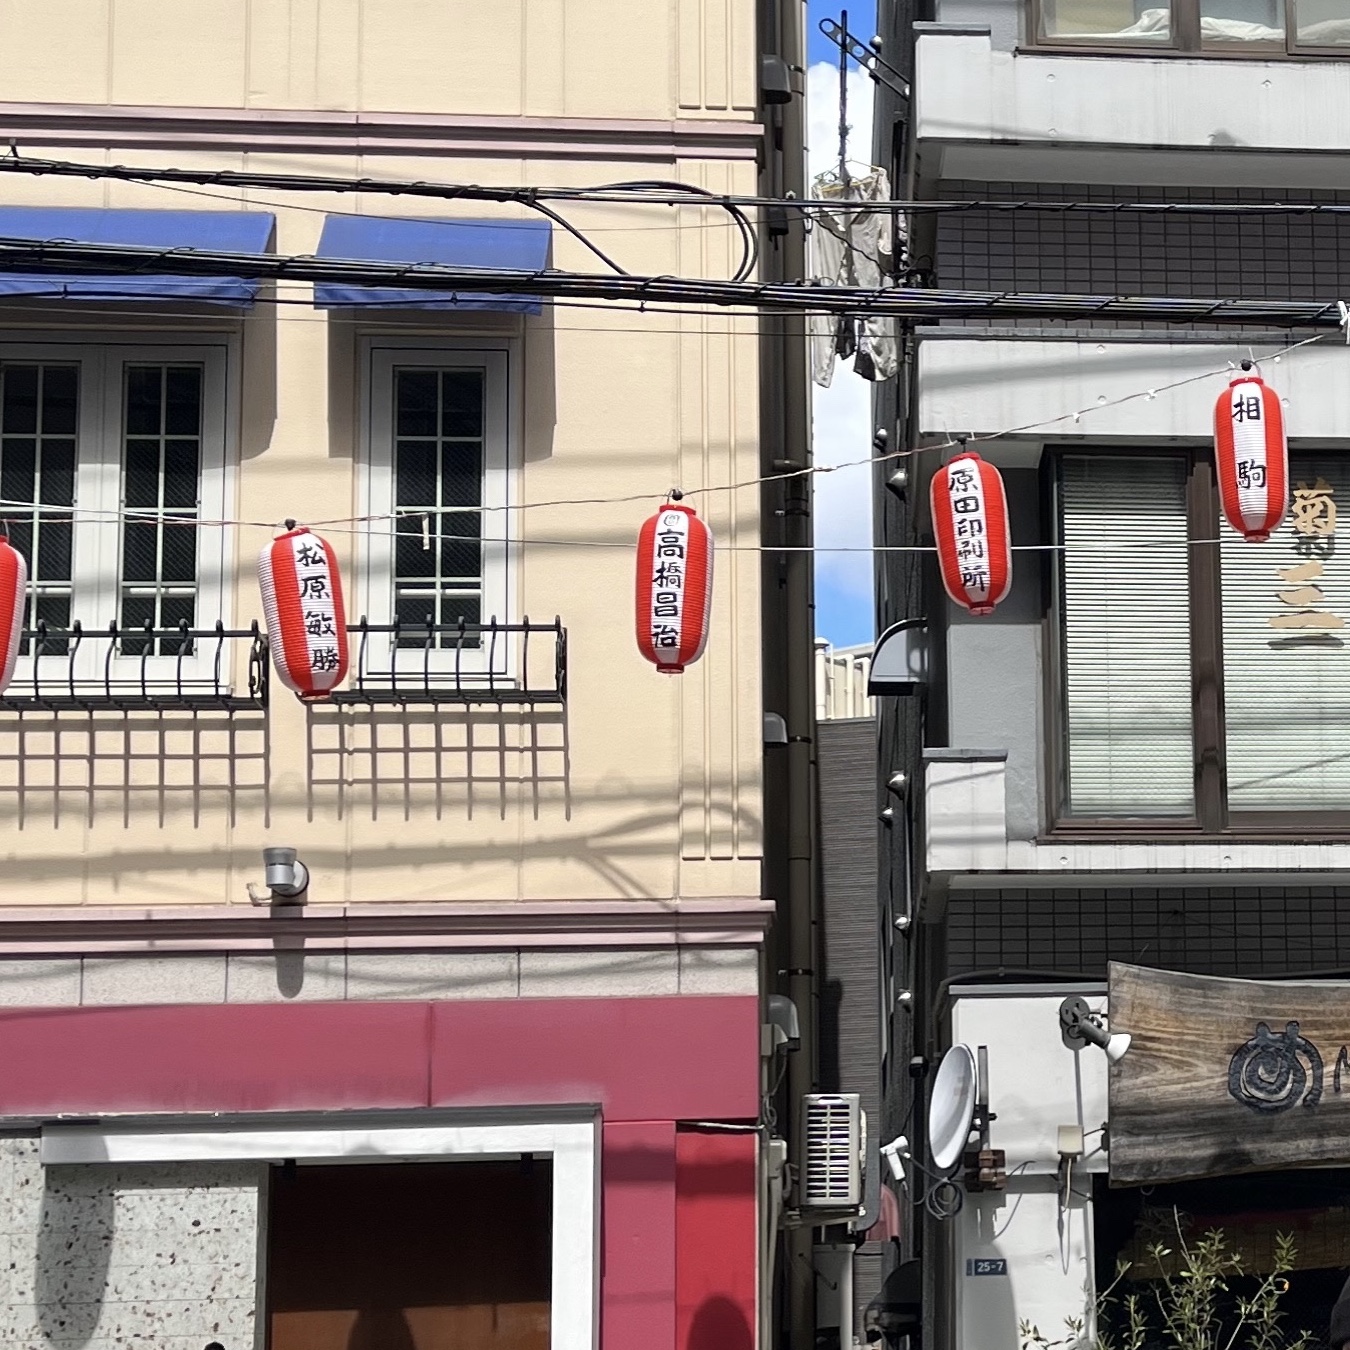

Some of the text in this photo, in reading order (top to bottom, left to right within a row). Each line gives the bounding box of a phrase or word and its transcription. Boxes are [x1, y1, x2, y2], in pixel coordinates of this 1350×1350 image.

[1232, 393, 1267, 490] 相駒
[651, 528, 685, 649] 高橋昌治
[949, 467, 987, 592] 原田印刷所
[296, 542, 340, 672] 松原敏勝
[977, 1261, 1004, 1273] 25-7
